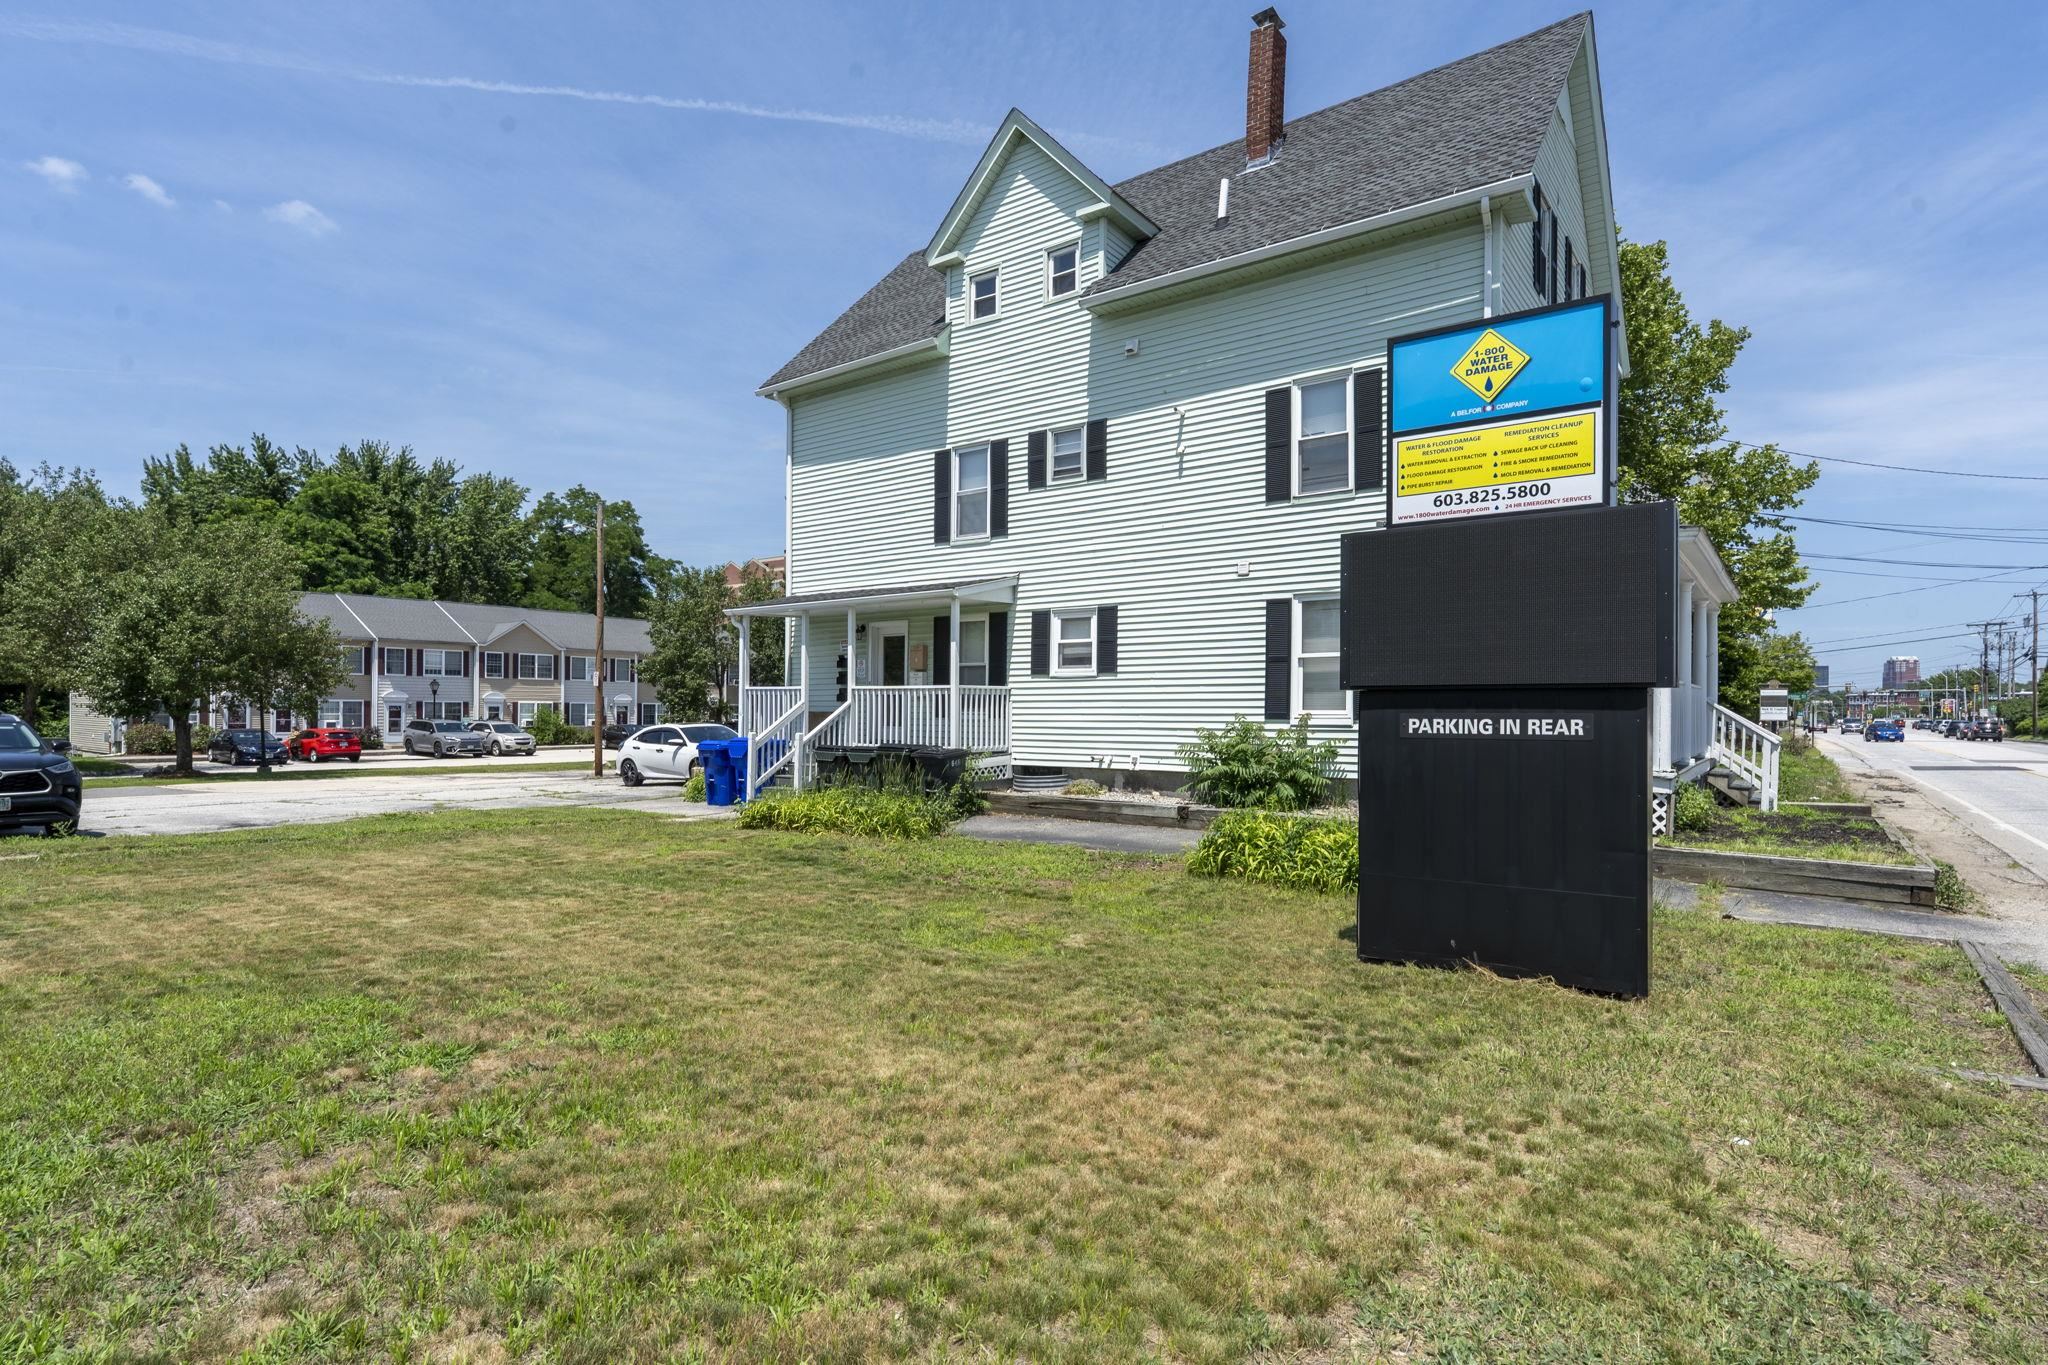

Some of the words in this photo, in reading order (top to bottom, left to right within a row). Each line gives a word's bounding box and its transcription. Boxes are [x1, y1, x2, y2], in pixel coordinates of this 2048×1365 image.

[1474, 346, 1505, 358] 1-800
[1470, 354, 1508, 366] WATER
[1466, 362, 1513, 376] DAMAGE
[1457, 407, 1482, 416] BELFOR
[1496, 400, 1529, 410] COMPANY
[1504, 426, 1550, 437] REMEDIATION
[1551, 420, 1583, 430] CLEANUP
[1406, 443, 1425, 451] WATER
[1432, 440, 1453, 448] FLOOD
[1454, 436, 1481, 444] DAMAGE
[1528, 432, 1559, 441] SERVICES
[1422, 446, 1464, 456] RESTORATION
[1549, 440, 1578, 448] CLEANING
[1454, 453, 1487, 461] EXTRACTION
[1539, 452, 1578, 461] REMEDIATION
[1518, 468, 1545, 476] REMOVAL
[1551, 462, 1591, 471] REMEDIATION
[1433, 482, 1551, 508] 603.825.5800
[1398, 506, 1490, 521] www.1800waterdamage.com
[1523, 499, 1560, 507] EMERGENCY
[1562, 495, 1592, 503] SERVICES
[1408, 718, 1493, 735] PARKING
[1500, 718, 1520, 735] IN
[1527, 719, 1584, 736] REAR
